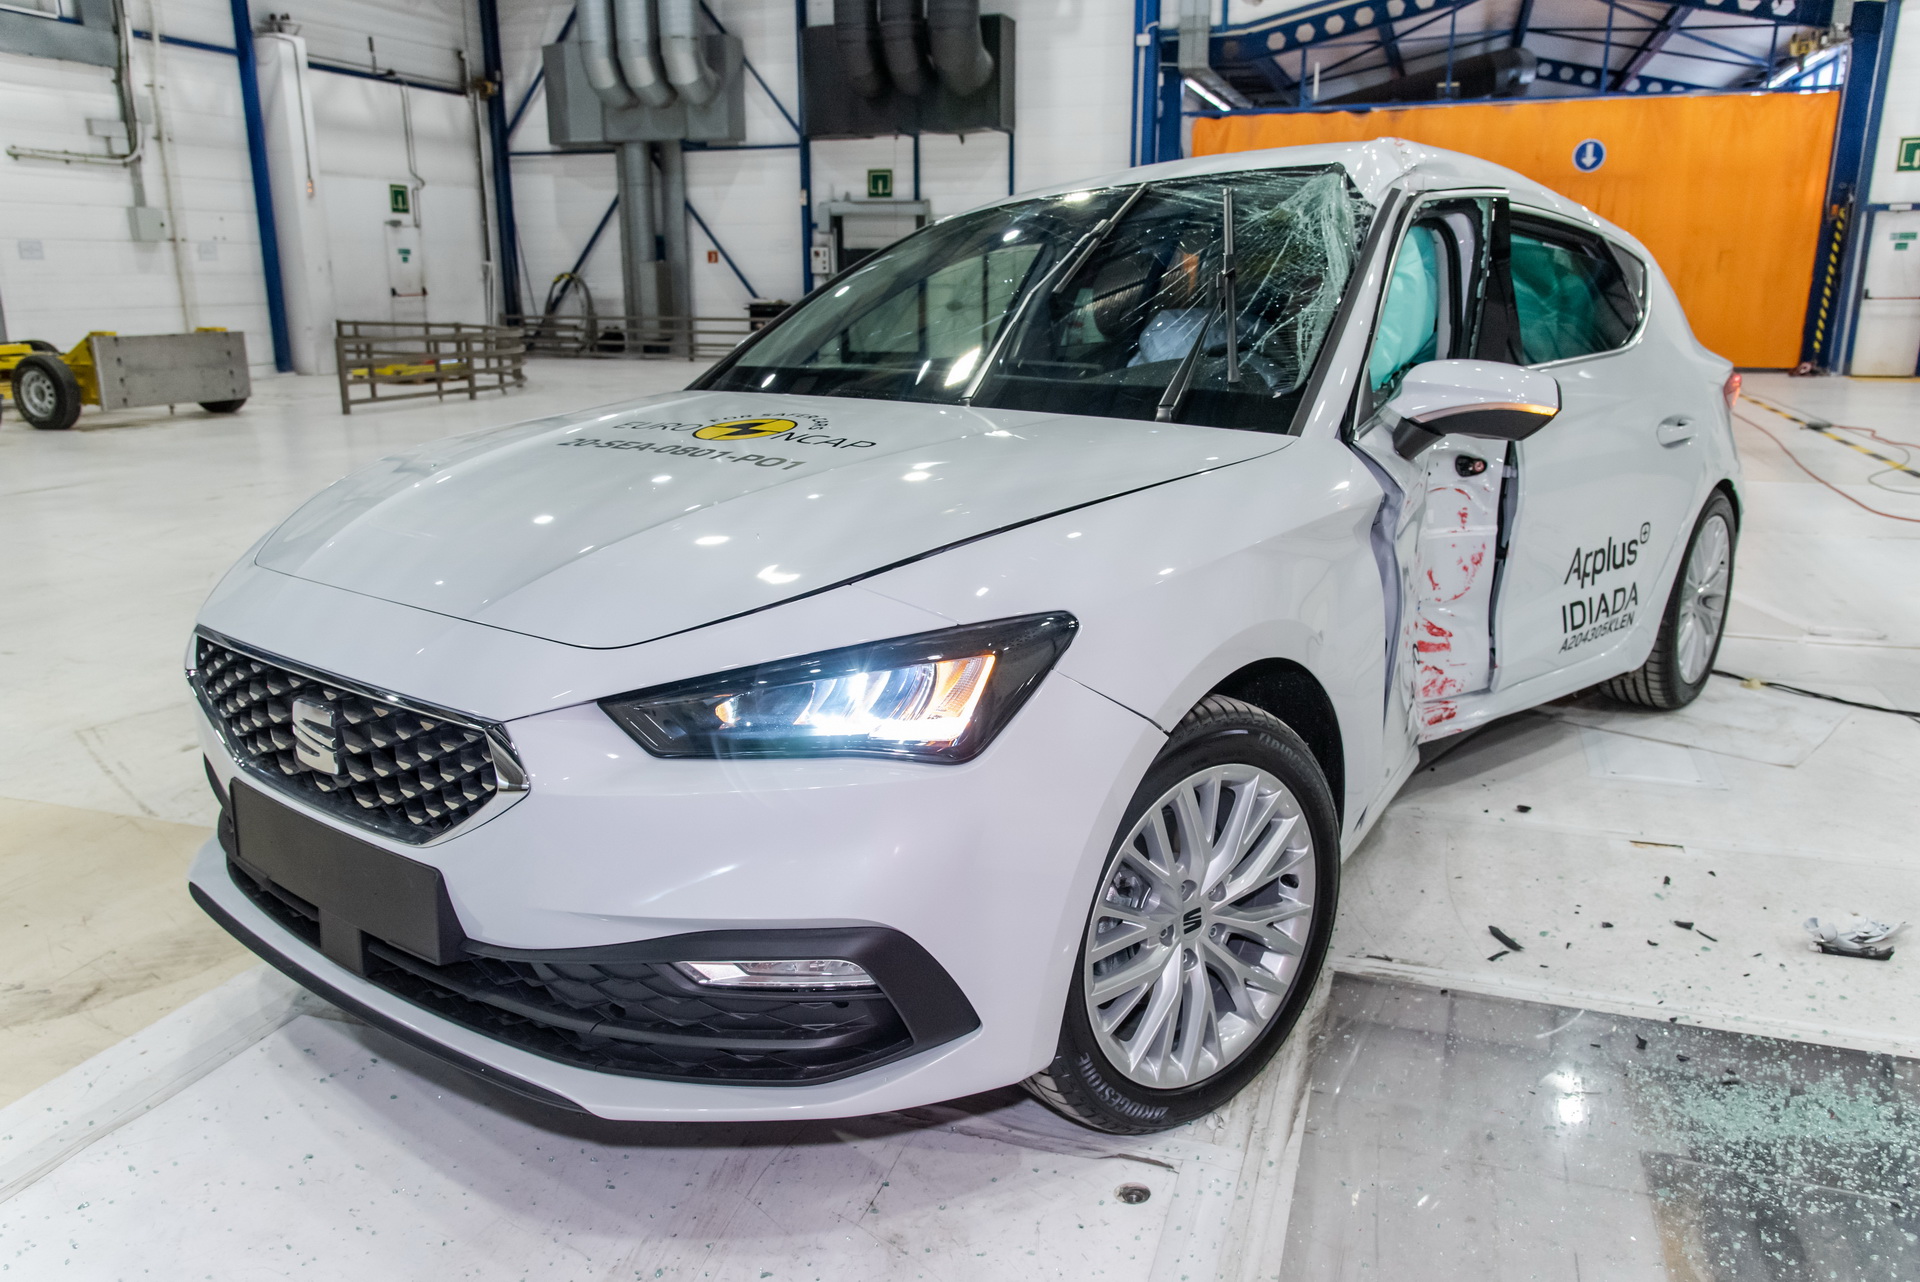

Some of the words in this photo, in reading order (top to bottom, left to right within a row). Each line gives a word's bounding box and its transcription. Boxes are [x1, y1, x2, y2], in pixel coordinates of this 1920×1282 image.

[613, 421, 703, 431] EURO
[770, 432, 877, 449] NCAP
[710, 414, 752, 422] FOR
[1562, 581, 1638, 634] IDIADA
[1079, 1052, 1169, 1120] BRIDGESTONE
